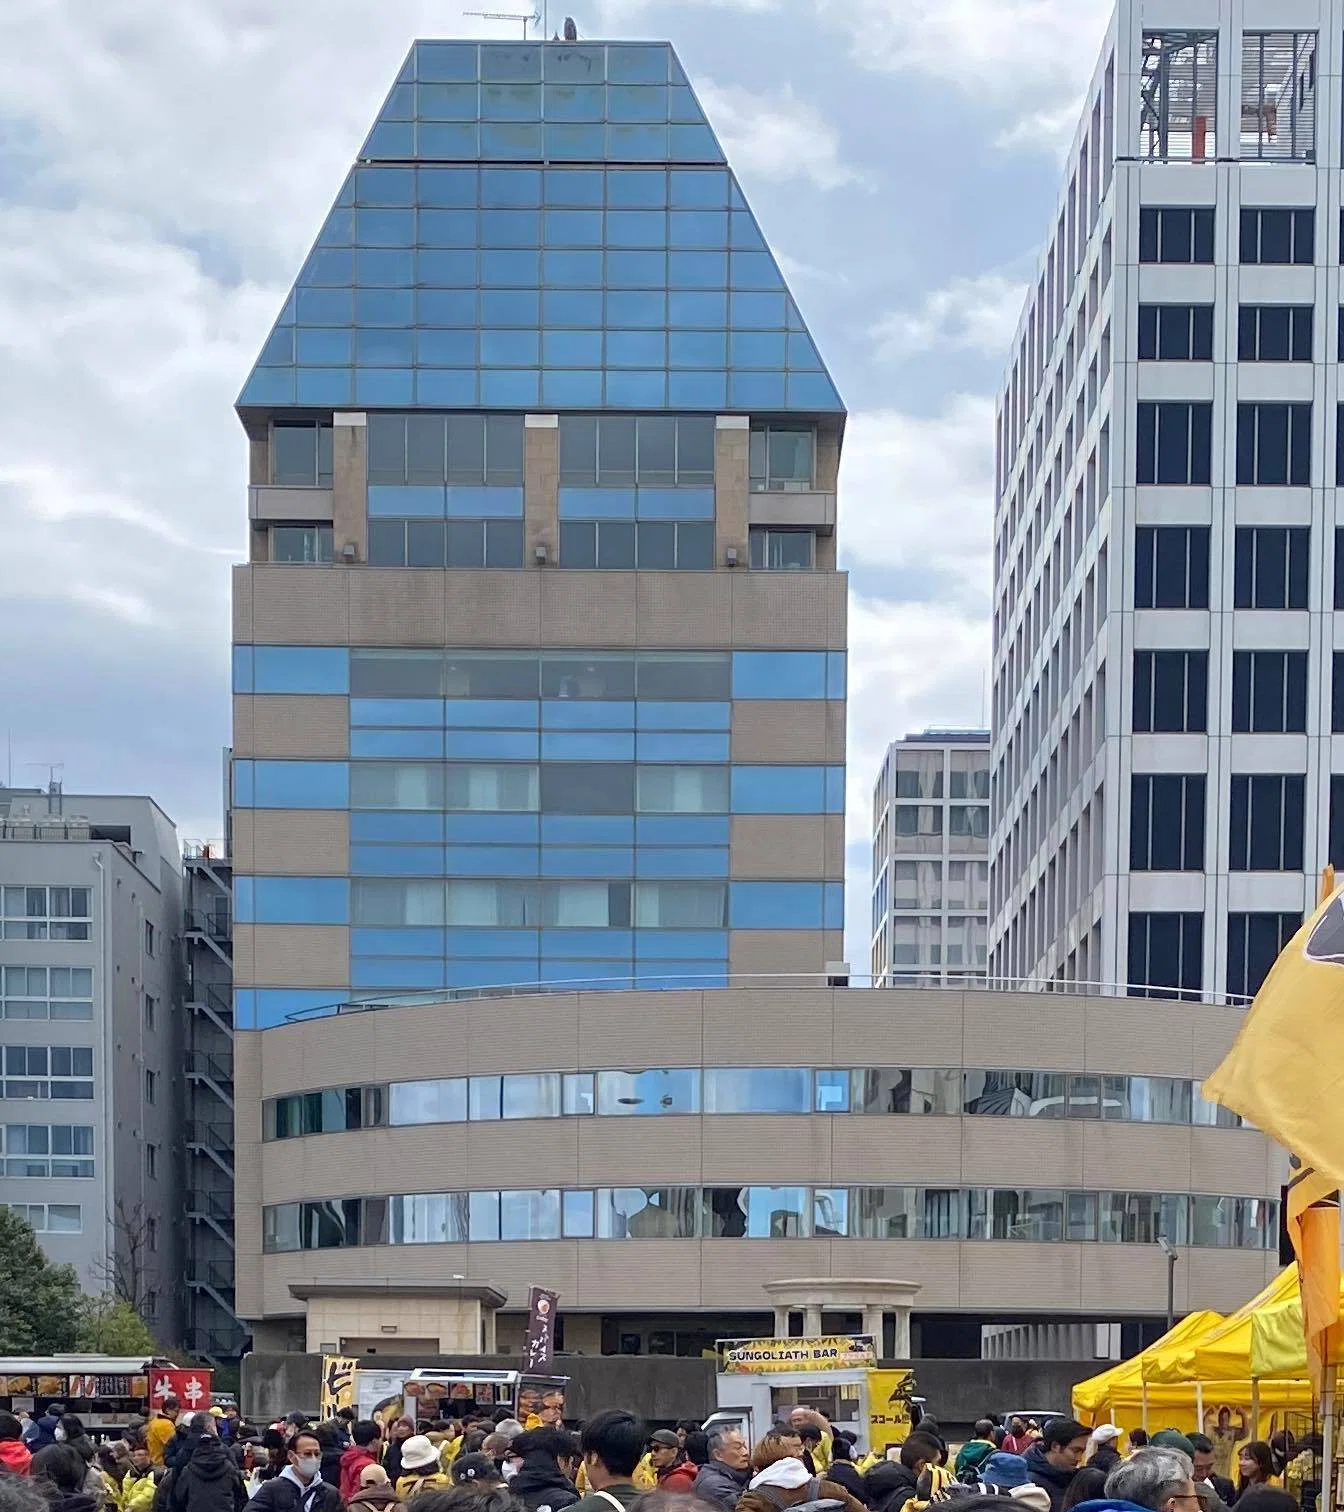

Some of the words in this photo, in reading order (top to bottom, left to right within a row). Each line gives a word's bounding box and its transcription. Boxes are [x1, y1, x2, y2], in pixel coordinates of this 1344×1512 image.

[729, 1350, 809, 1361] SUNGOLIATH
[813, 1348, 838, 1359] BAR
[155, 1375, 204, 1408] 牛串
